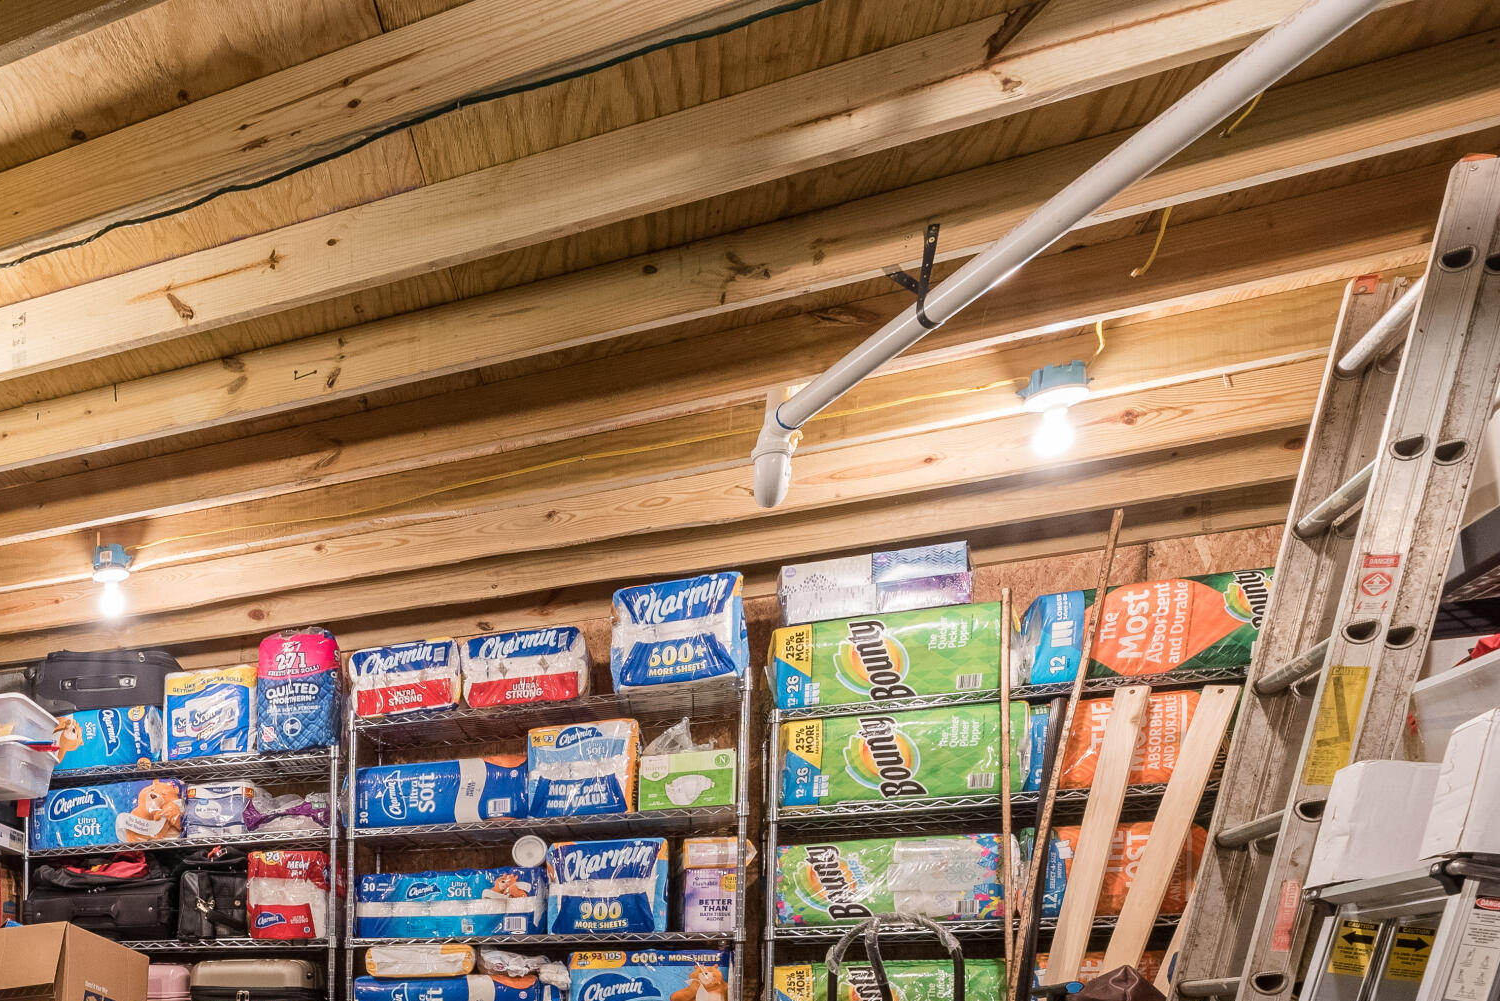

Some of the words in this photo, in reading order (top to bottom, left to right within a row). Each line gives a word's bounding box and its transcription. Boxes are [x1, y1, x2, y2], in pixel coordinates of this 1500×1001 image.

[631, 574, 727, 625] Charmin
[1169, 581, 1189, 635] Durable
[936, 615, 948, 651] Quicker
[947, 620, 958, 650] Picker
[957, 617, 969, 648] Upper
[1100, 610, 1120, 643] The
[1116, 588, 1150, 660] Most
[1145, 581, 1170, 664] Absorbent
[478, 628, 557, 659] Charmin
[785, 636, 796, 661] 25%
[795, 630, 806, 662] MORE
[926, 634, 938, 651] The
[1168, 638, 1181, 665] and
[361, 644, 433, 678] Charmin
[648, 666, 674, 677] MORE
[675, 661, 706, 673] SHEETS
[847, 618, 919, 702] Bounty
[1049, 654, 1066, 675] 12
[265, 682, 319, 701] QUILTED
[387, 693, 423, 706] STRONG
[505, 687, 544, 700] STRONG
[1164, 694, 1177, 743] DURABLE
[795, 728, 806, 754] 25%
[805, 723, 815, 755] MORE
[958, 717, 969, 749] Picker
[968, 717, 981, 748] Upper
[1147, 696, 1162, 770] ABSORBENT
[719, 756, 727, 766] N
[857, 714, 930, 800] Bounty
[1163, 743, 1175, 770] AND
[54, 796, 95, 815] Charmin
[387, 777, 402, 816] Charmin
[409, 778, 419, 808] Ultra
[418, 771, 435, 813] Soft
[73, 821, 101, 837] Soft
[77, 815, 98, 825] Ultra
[359, 810, 369, 824] 30
[563, 841, 651, 882] Charmin
[362, 882, 375, 892] 30
[408, 883, 436, 898] Charmin
[447, 886, 472, 898] Soft
[574, 919, 598, 930] MORE
[598, 917, 628, 929] SHEETS
[580, 902, 623, 920] 900
[1347, 921, 1376, 931] CAUTION
[1403, 927, 1431, 936] CAUTION
[668, 954, 691, 963] MORE
[692, 954, 721, 962] SHEETS
